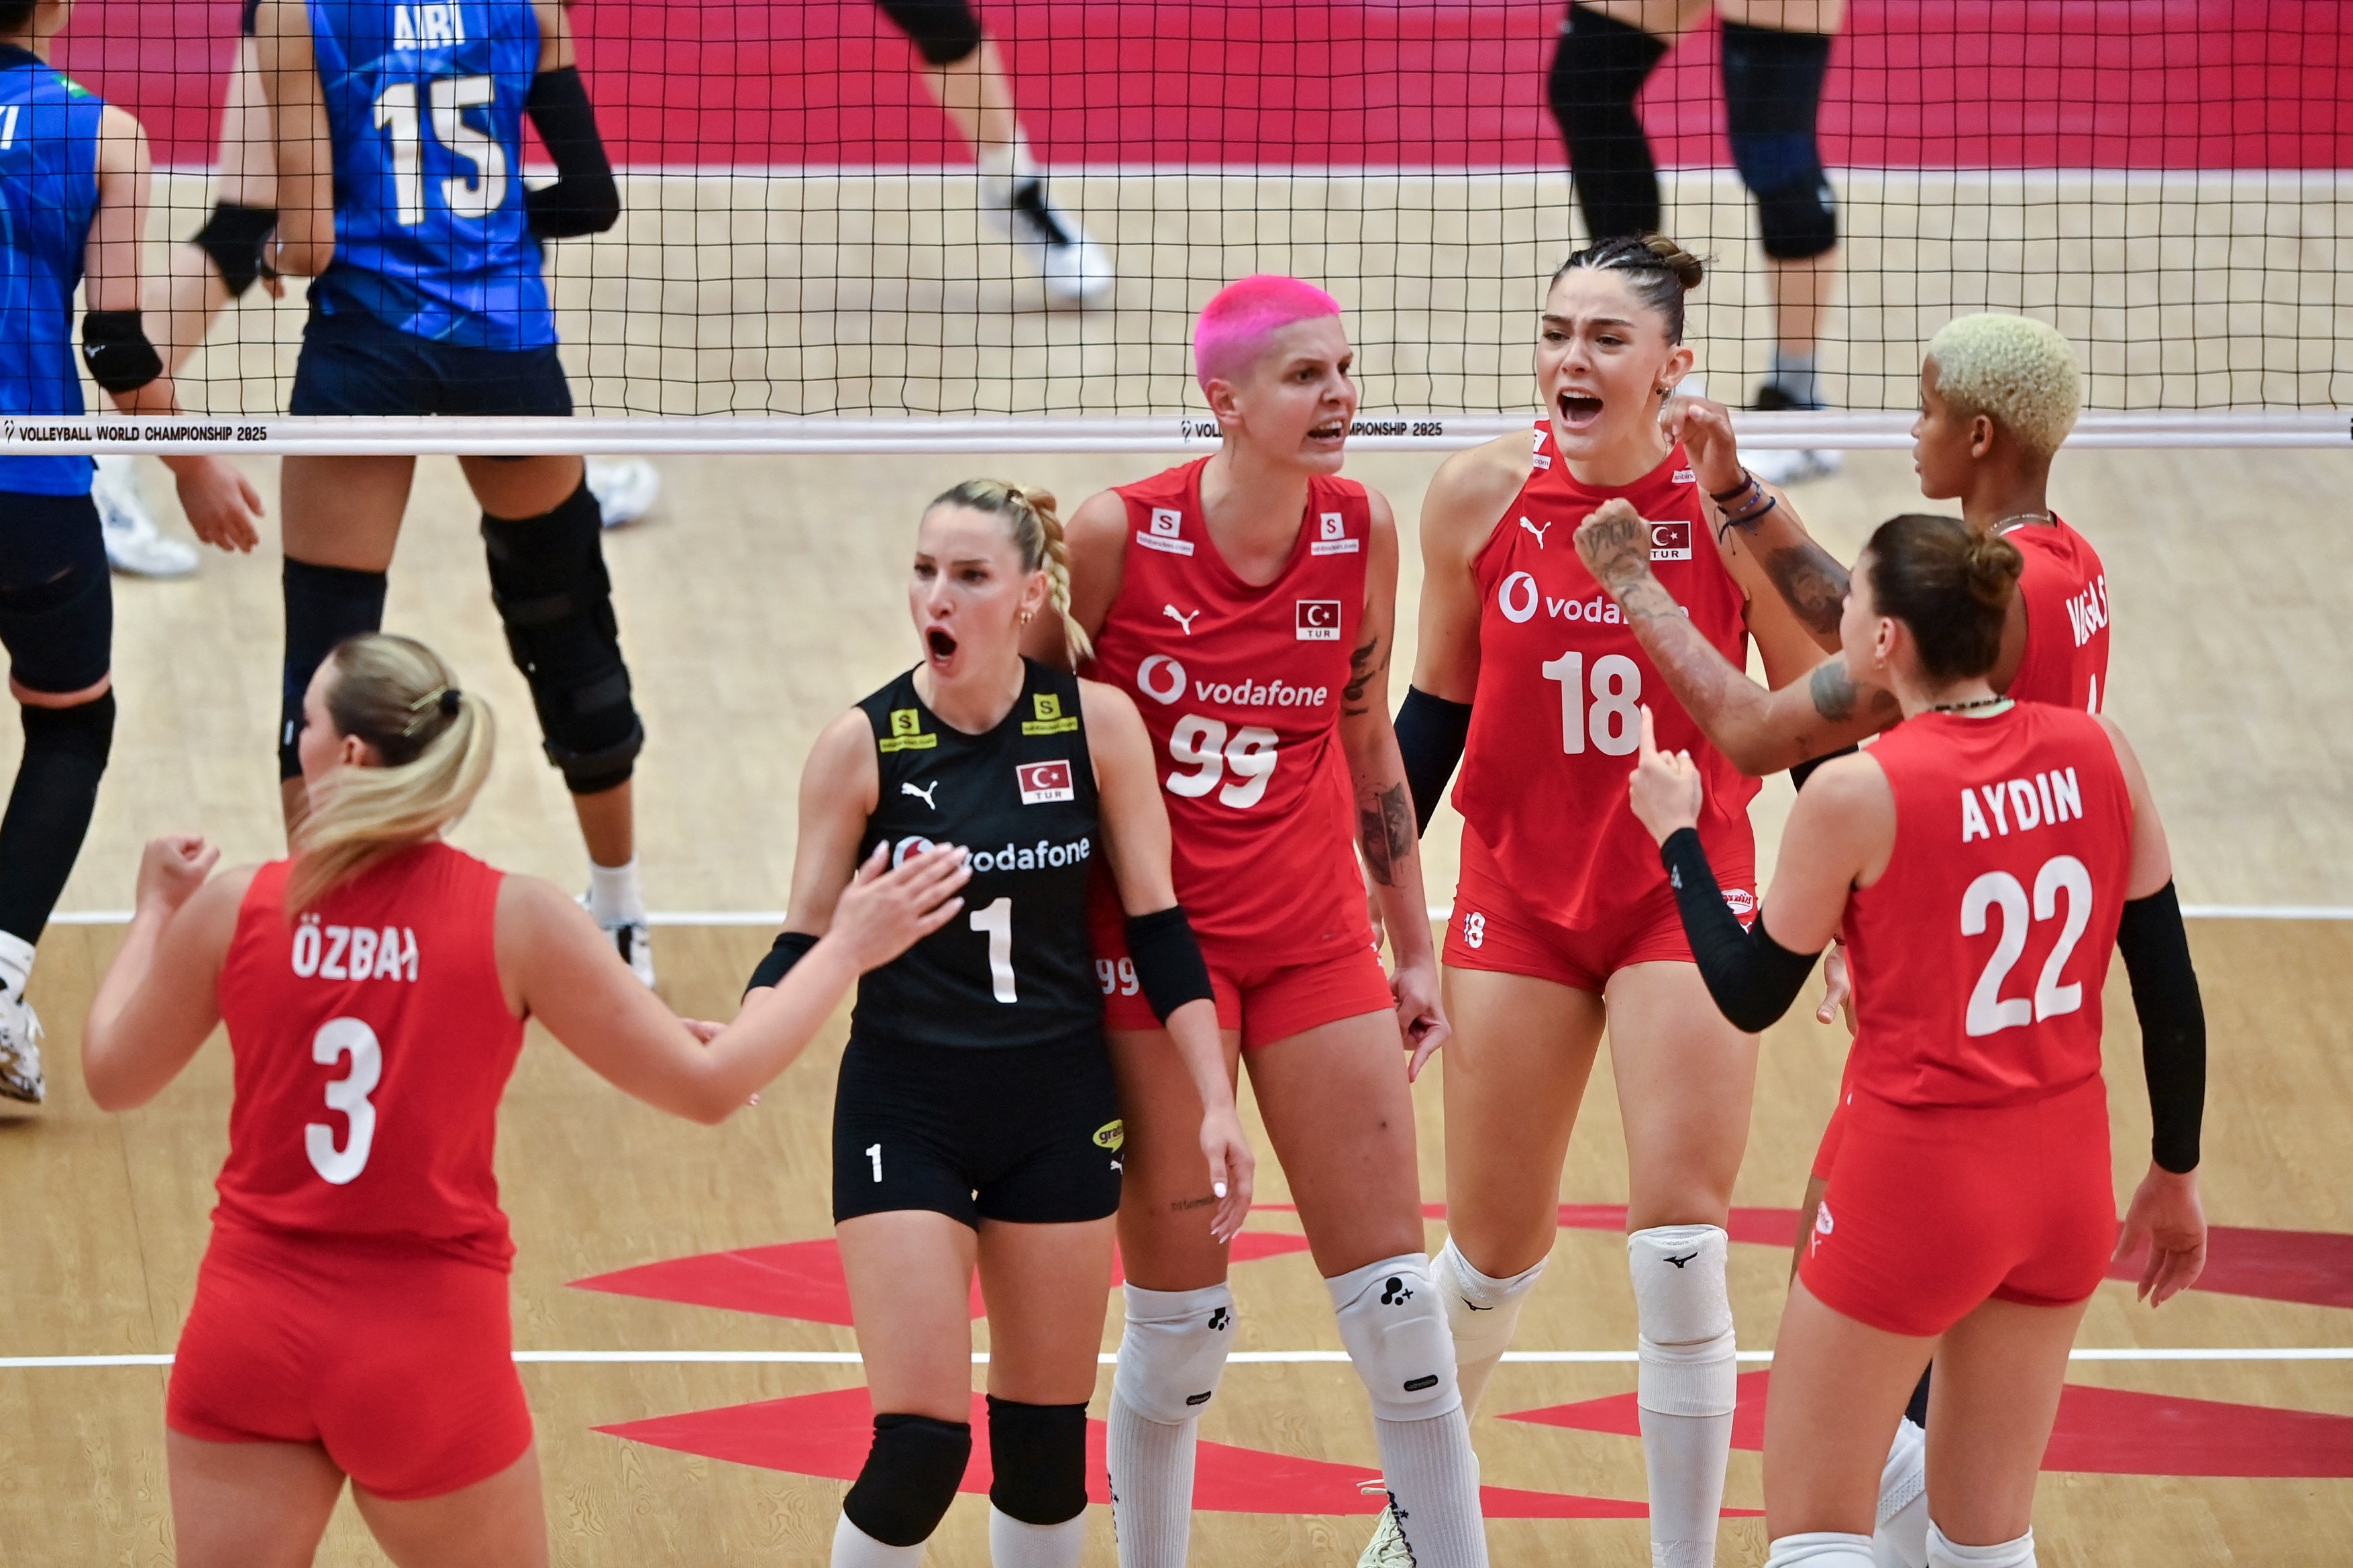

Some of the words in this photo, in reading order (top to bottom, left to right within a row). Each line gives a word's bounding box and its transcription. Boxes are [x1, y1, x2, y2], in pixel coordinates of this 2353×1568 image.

[394, 0, 466, 51] AIRI
[373, 76, 508, 226] 15
[19, 427, 92, 441] VOLLEYBALL
[97, 425, 140, 441] WORLD
[145, 426, 232, 441] CHAMPIONSHIP
[237, 426, 267, 441] 2025
[1349, 422, 1406, 436] MPIONSHIP
[1412, 422, 1443, 436] 2025
[1158, 515, 1173, 530] S
[1326, 519, 1337, 533] S
[1650, 550, 1679, 558] TUR
[1307, 630, 1330, 638] TUR
[1039, 700, 1053, 715] S
[1194, 678, 1328, 707] vodafone
[1542, 651, 1642, 755] 18
[898, 715, 912, 729] S
[1166, 713, 1279, 809] 99
[1036, 791, 1062, 799] TUR
[1961, 766, 2083, 843] AYDIN
[970, 896, 1018, 1004] 1
[1960, 854, 2093, 1037] 22
[1096, 957, 1140, 996] 99
[304, 1016, 382, 1186] 3
[866, 1143, 882, 1183] 1
